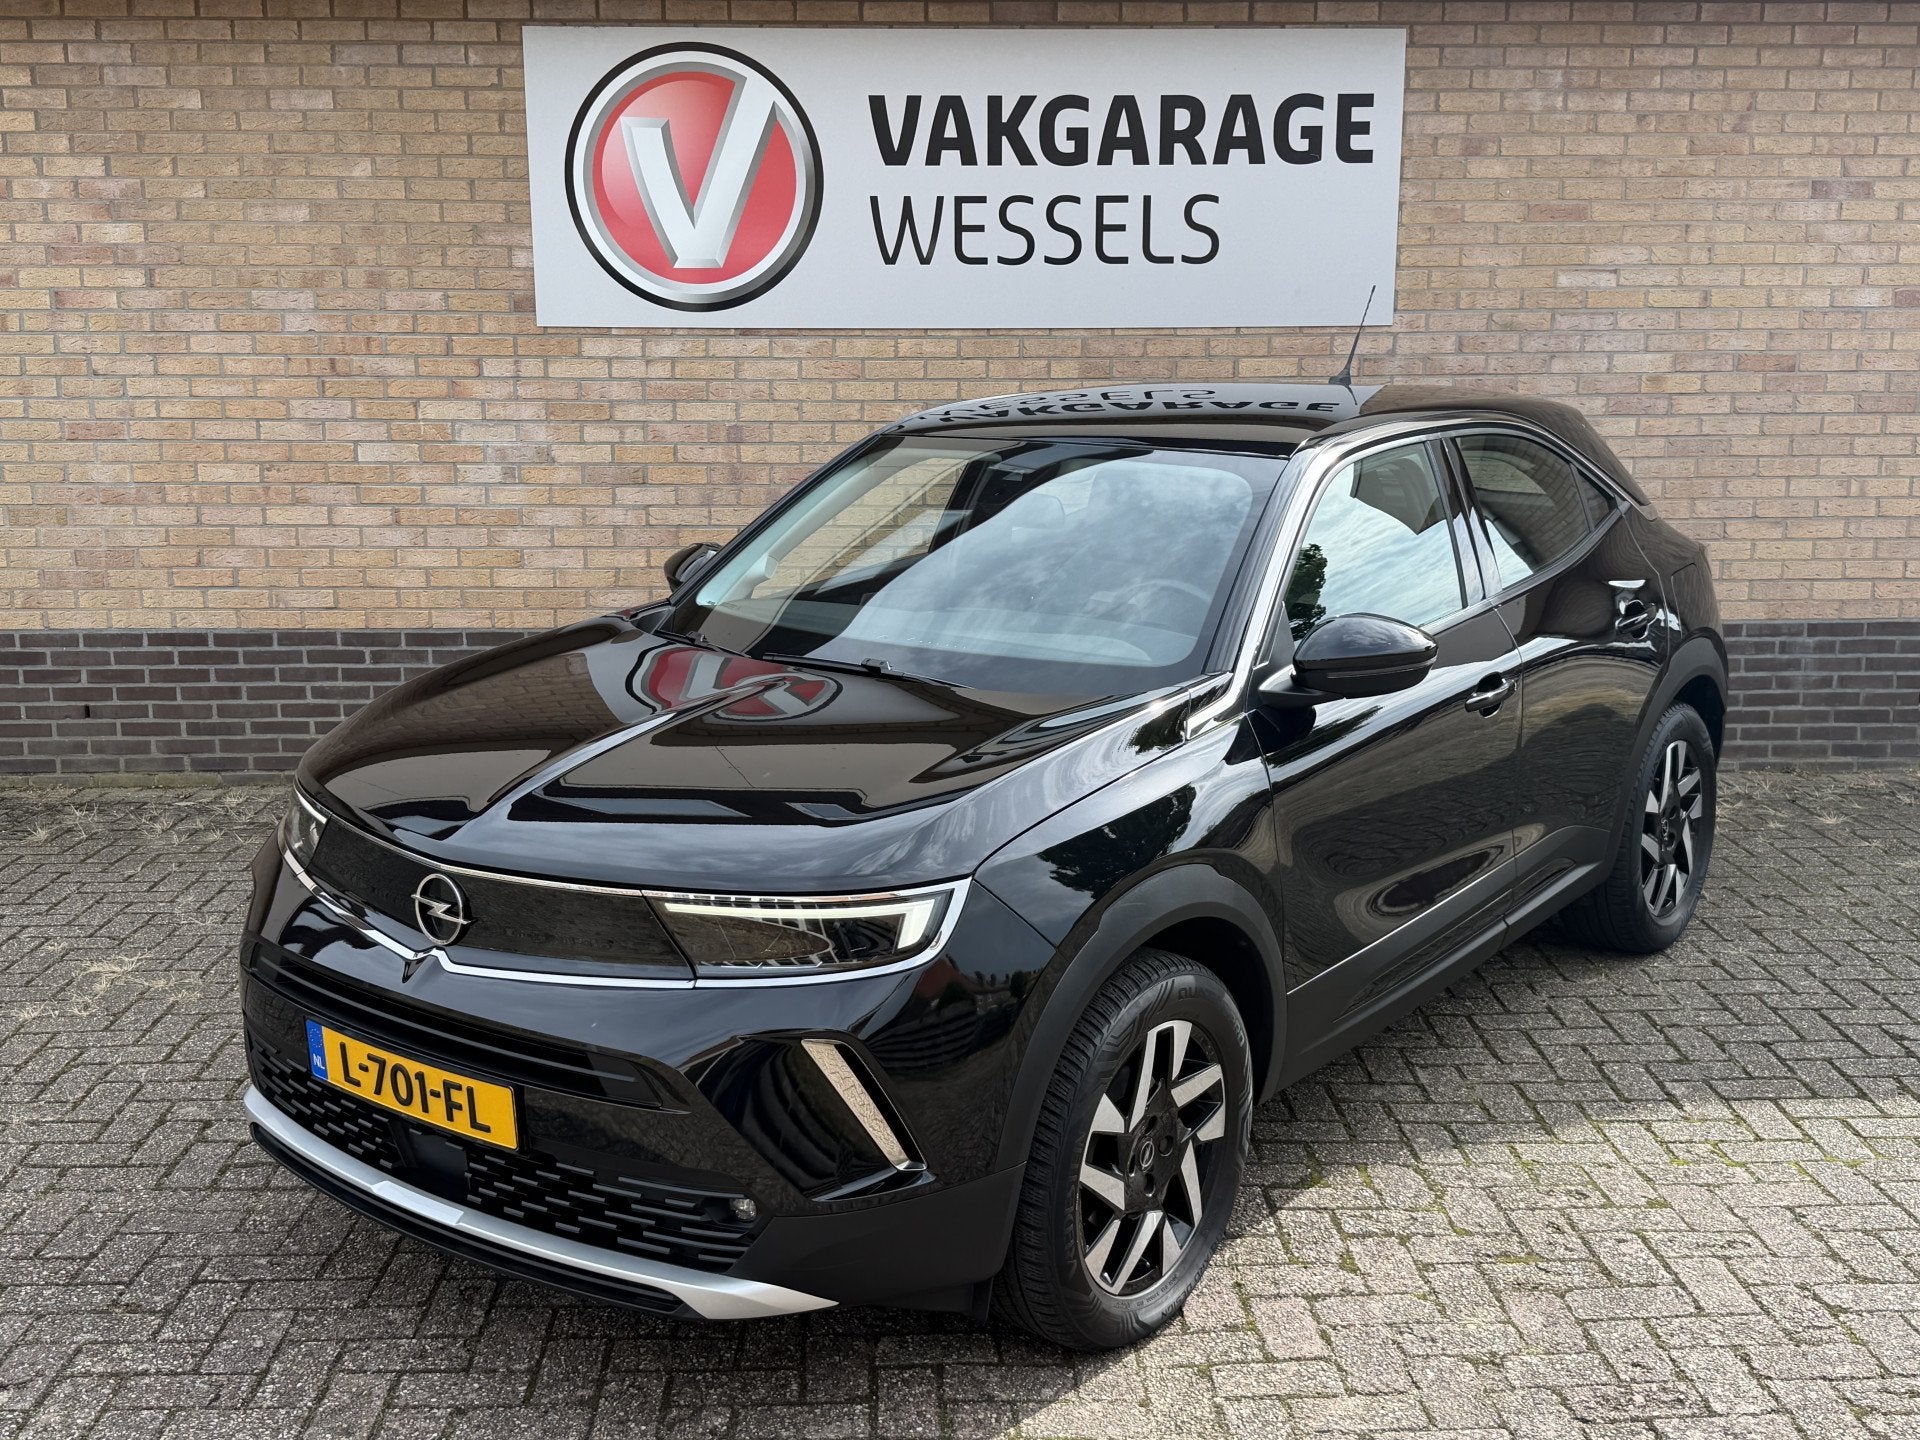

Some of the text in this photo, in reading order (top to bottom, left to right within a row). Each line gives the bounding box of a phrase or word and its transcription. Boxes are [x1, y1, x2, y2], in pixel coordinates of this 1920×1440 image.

[620, 65, 776, 269] V
[868, 93, 1375, 167] VAKGARAGE
[870, 194, 1221, 266] WESSELS
[312, 1053, 325, 1070] NL
[339, 1041, 492, 1134] L-701-FL
